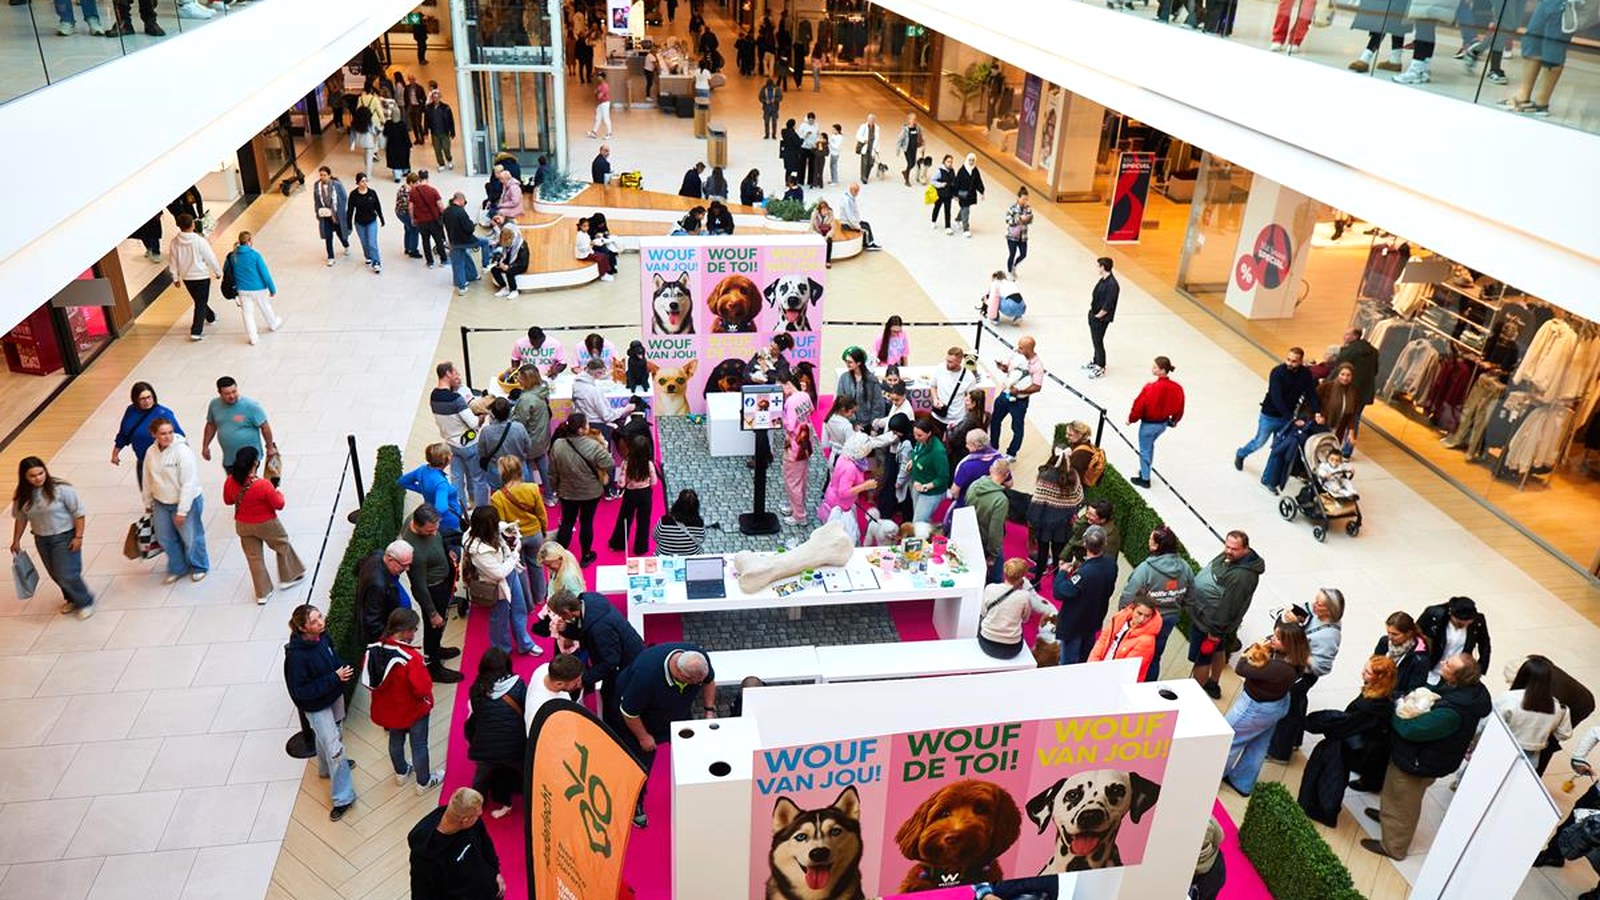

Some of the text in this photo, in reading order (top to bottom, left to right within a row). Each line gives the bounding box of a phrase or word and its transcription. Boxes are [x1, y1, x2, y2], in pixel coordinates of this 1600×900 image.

[649, 248, 696, 261] WOUF
[708, 248, 758, 260] WOUF
[646, 262, 698, 272] VAN JOU!
[707, 262, 726, 273] DE
[730, 261, 758, 273] TOI!
[648, 339, 692, 350] WOUF
[520, 347, 555, 357] WOUF
[646, 350, 670, 359] VAN
[671, 350, 697, 358] JOU!
[916, 400, 933, 409] TO
[1055, 713, 1166, 743] WOUF
[907, 723, 1022, 757] WOUF
[764, 739, 878, 774] WOUF
[1036, 738, 1170, 767] VAN JOU!
[902, 750, 1020, 782] DE TOI!
[757, 764, 882, 795] VAN JOU!
